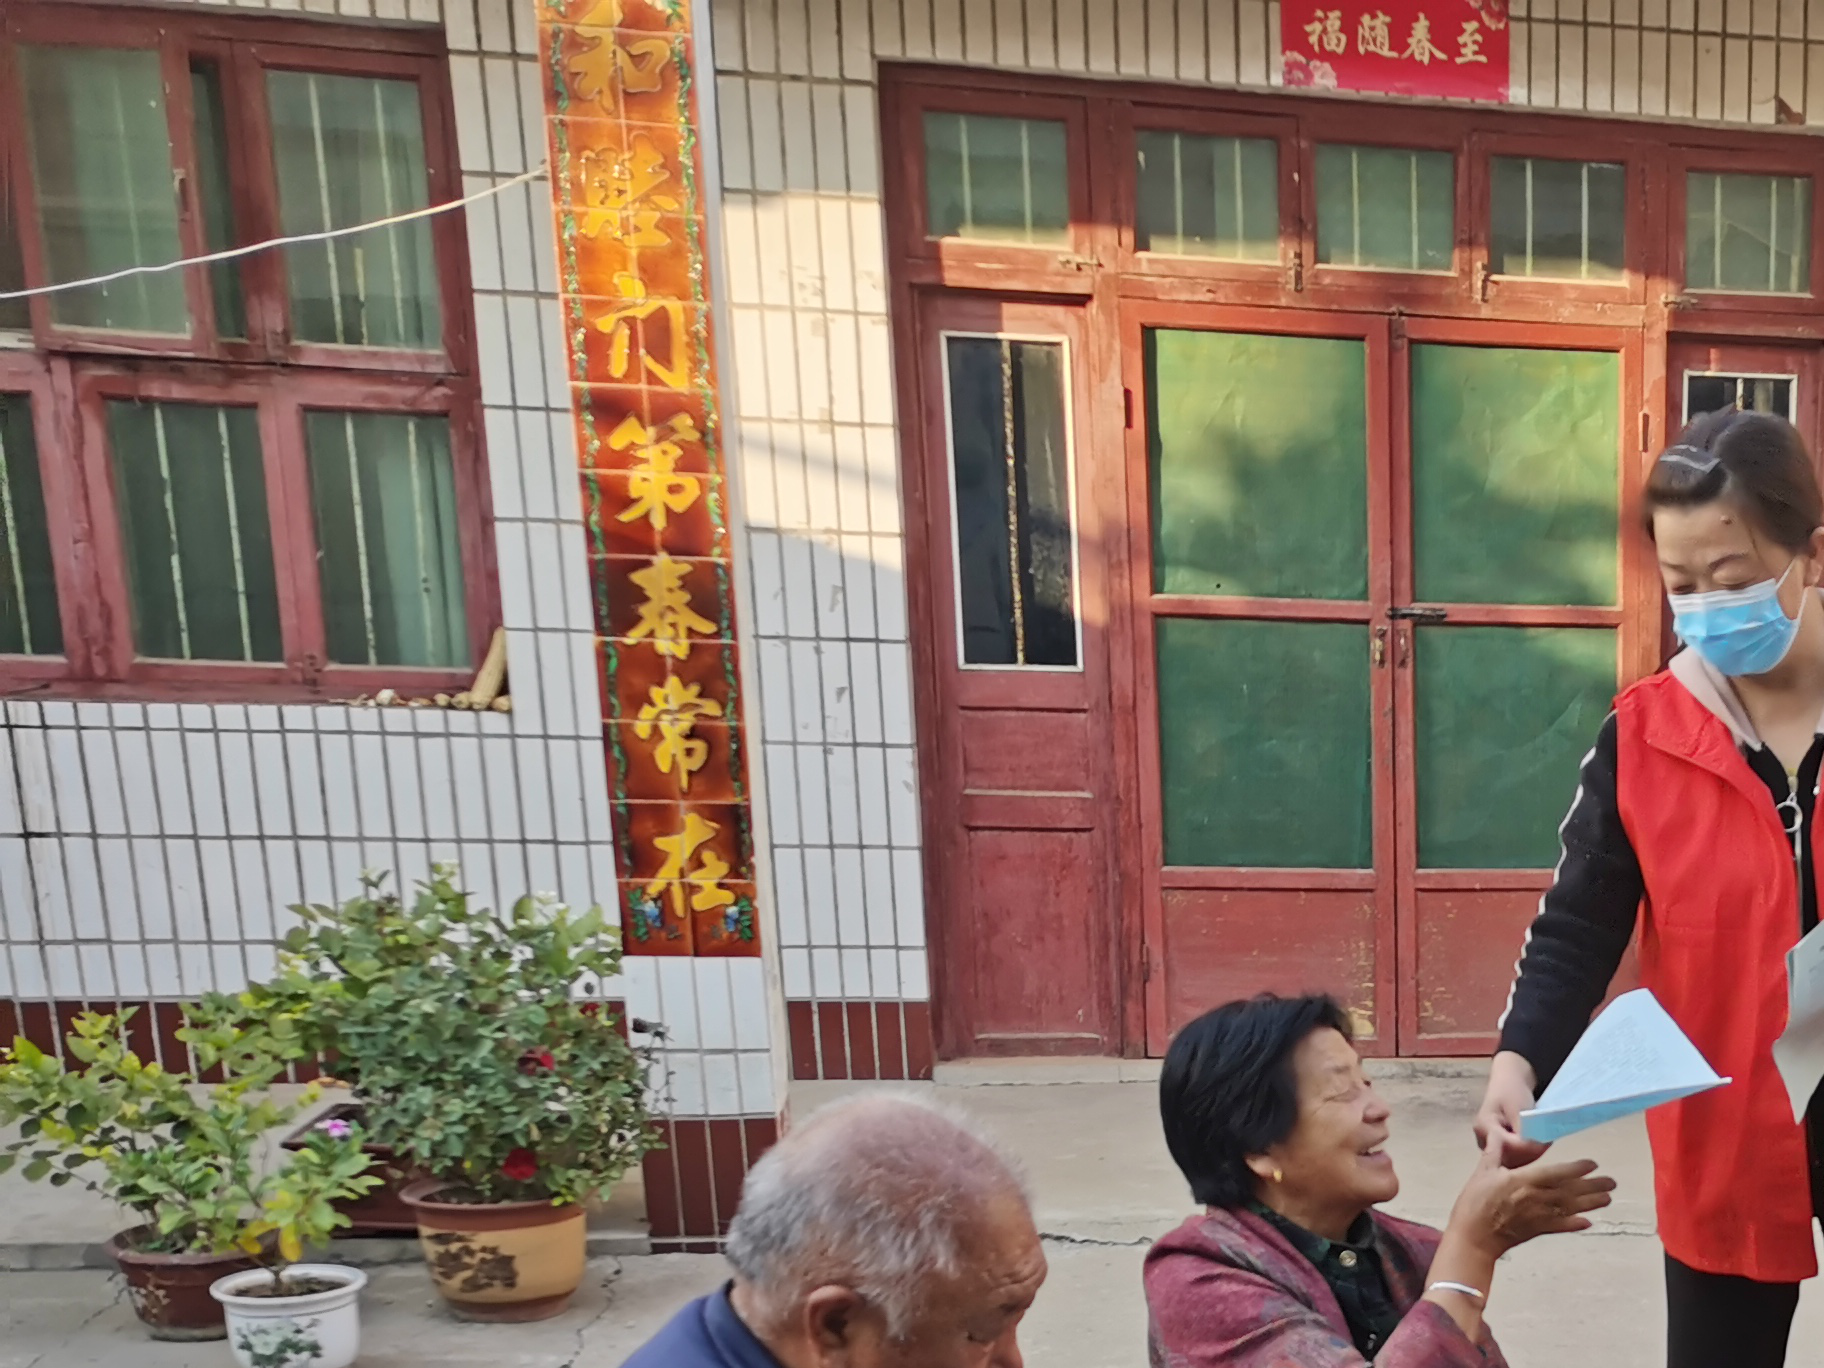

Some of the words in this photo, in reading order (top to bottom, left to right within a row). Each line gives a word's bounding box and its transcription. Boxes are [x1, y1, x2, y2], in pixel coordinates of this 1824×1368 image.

[1303, 9, 1489, 66] 福随春至
[566, 0, 736, 919] 和睦门第春常在
